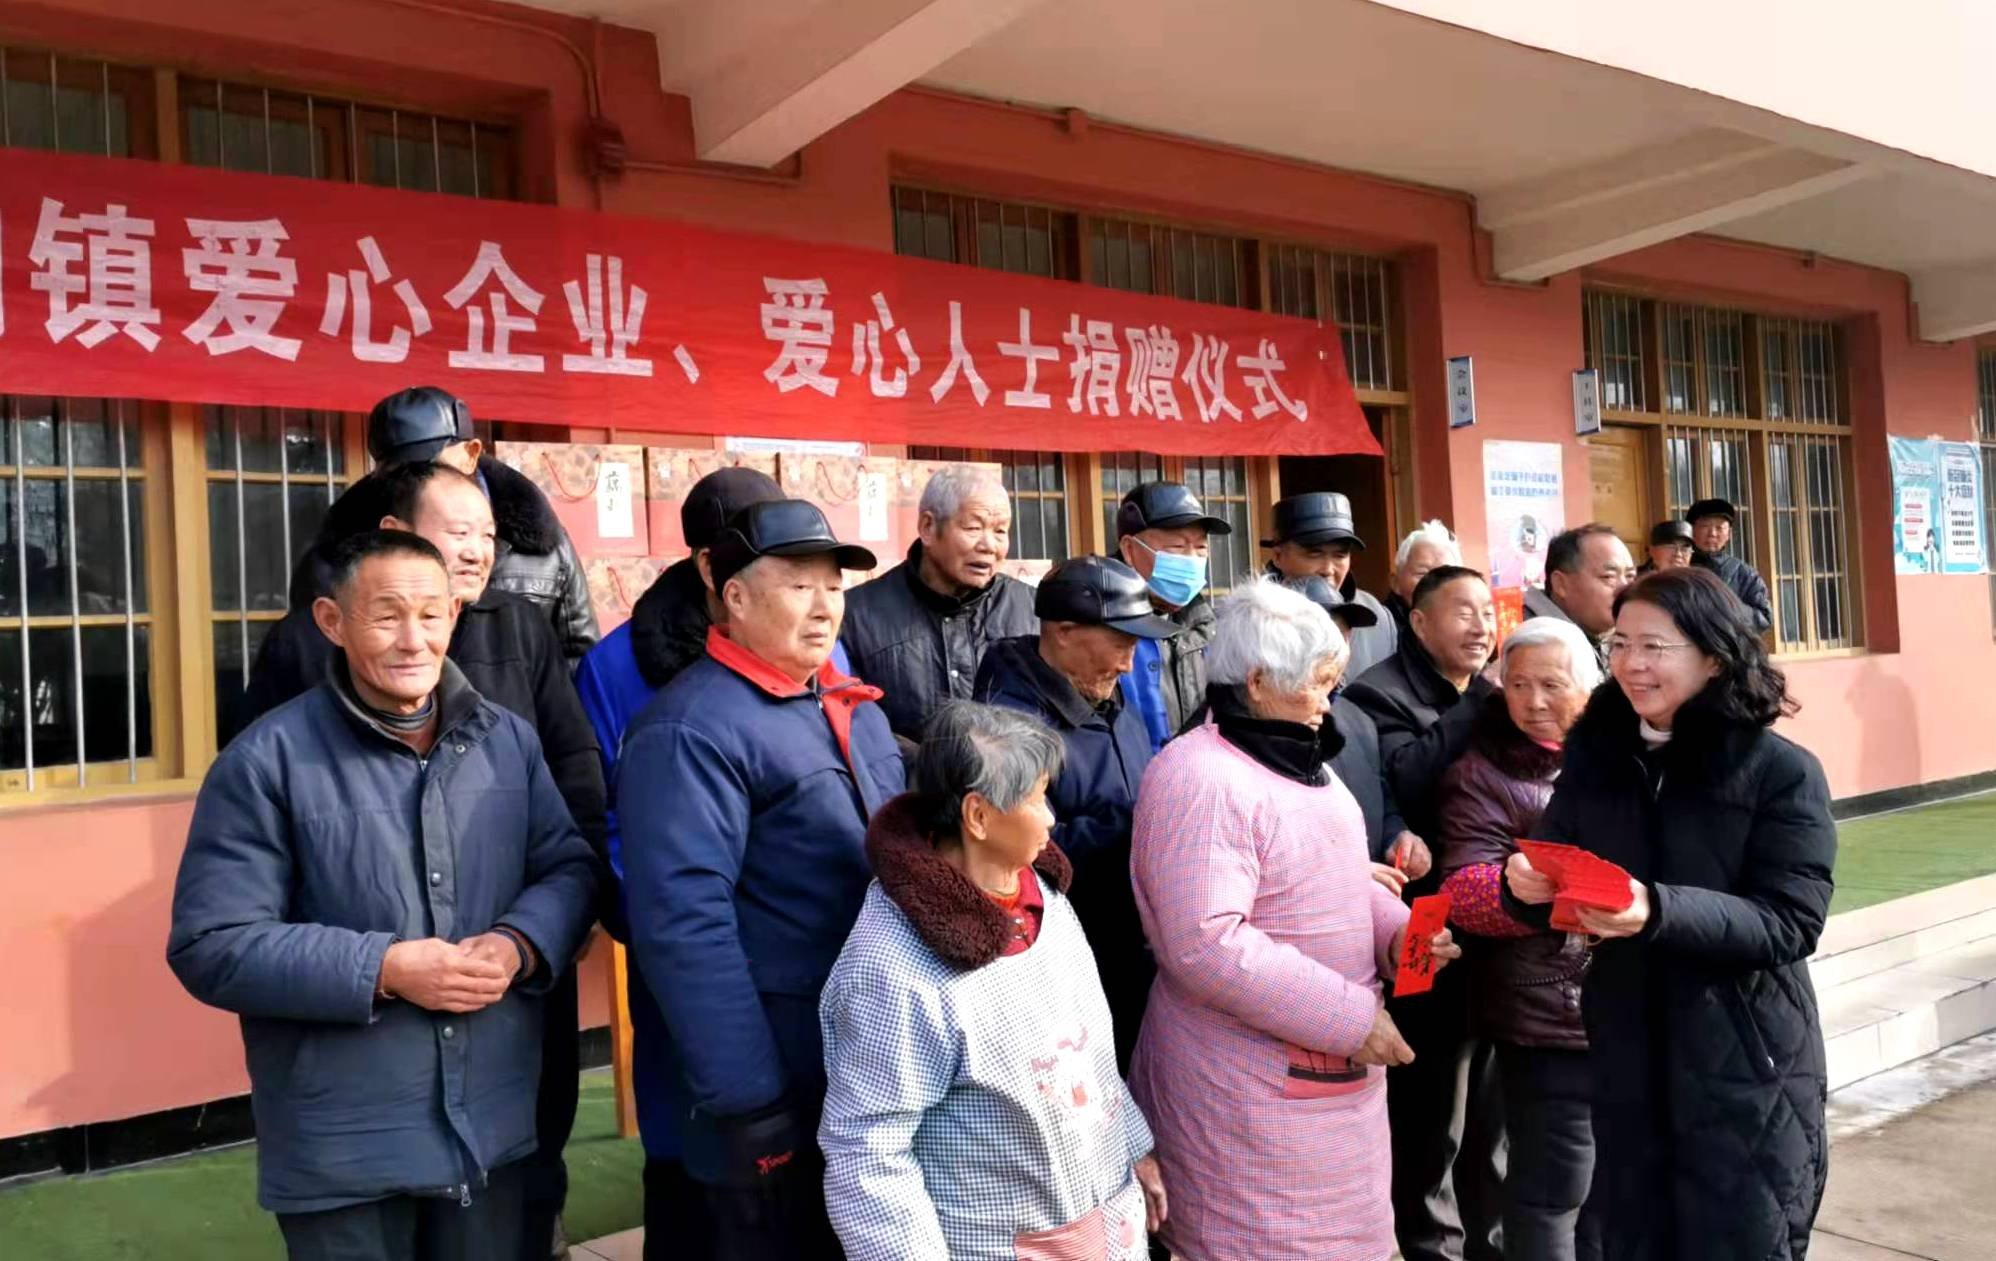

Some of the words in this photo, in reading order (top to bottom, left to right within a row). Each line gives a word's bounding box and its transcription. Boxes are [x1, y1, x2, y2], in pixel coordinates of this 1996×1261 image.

[0, 197, 1308, 423] 镇爱心企业、爱心人士捐赠仪式
